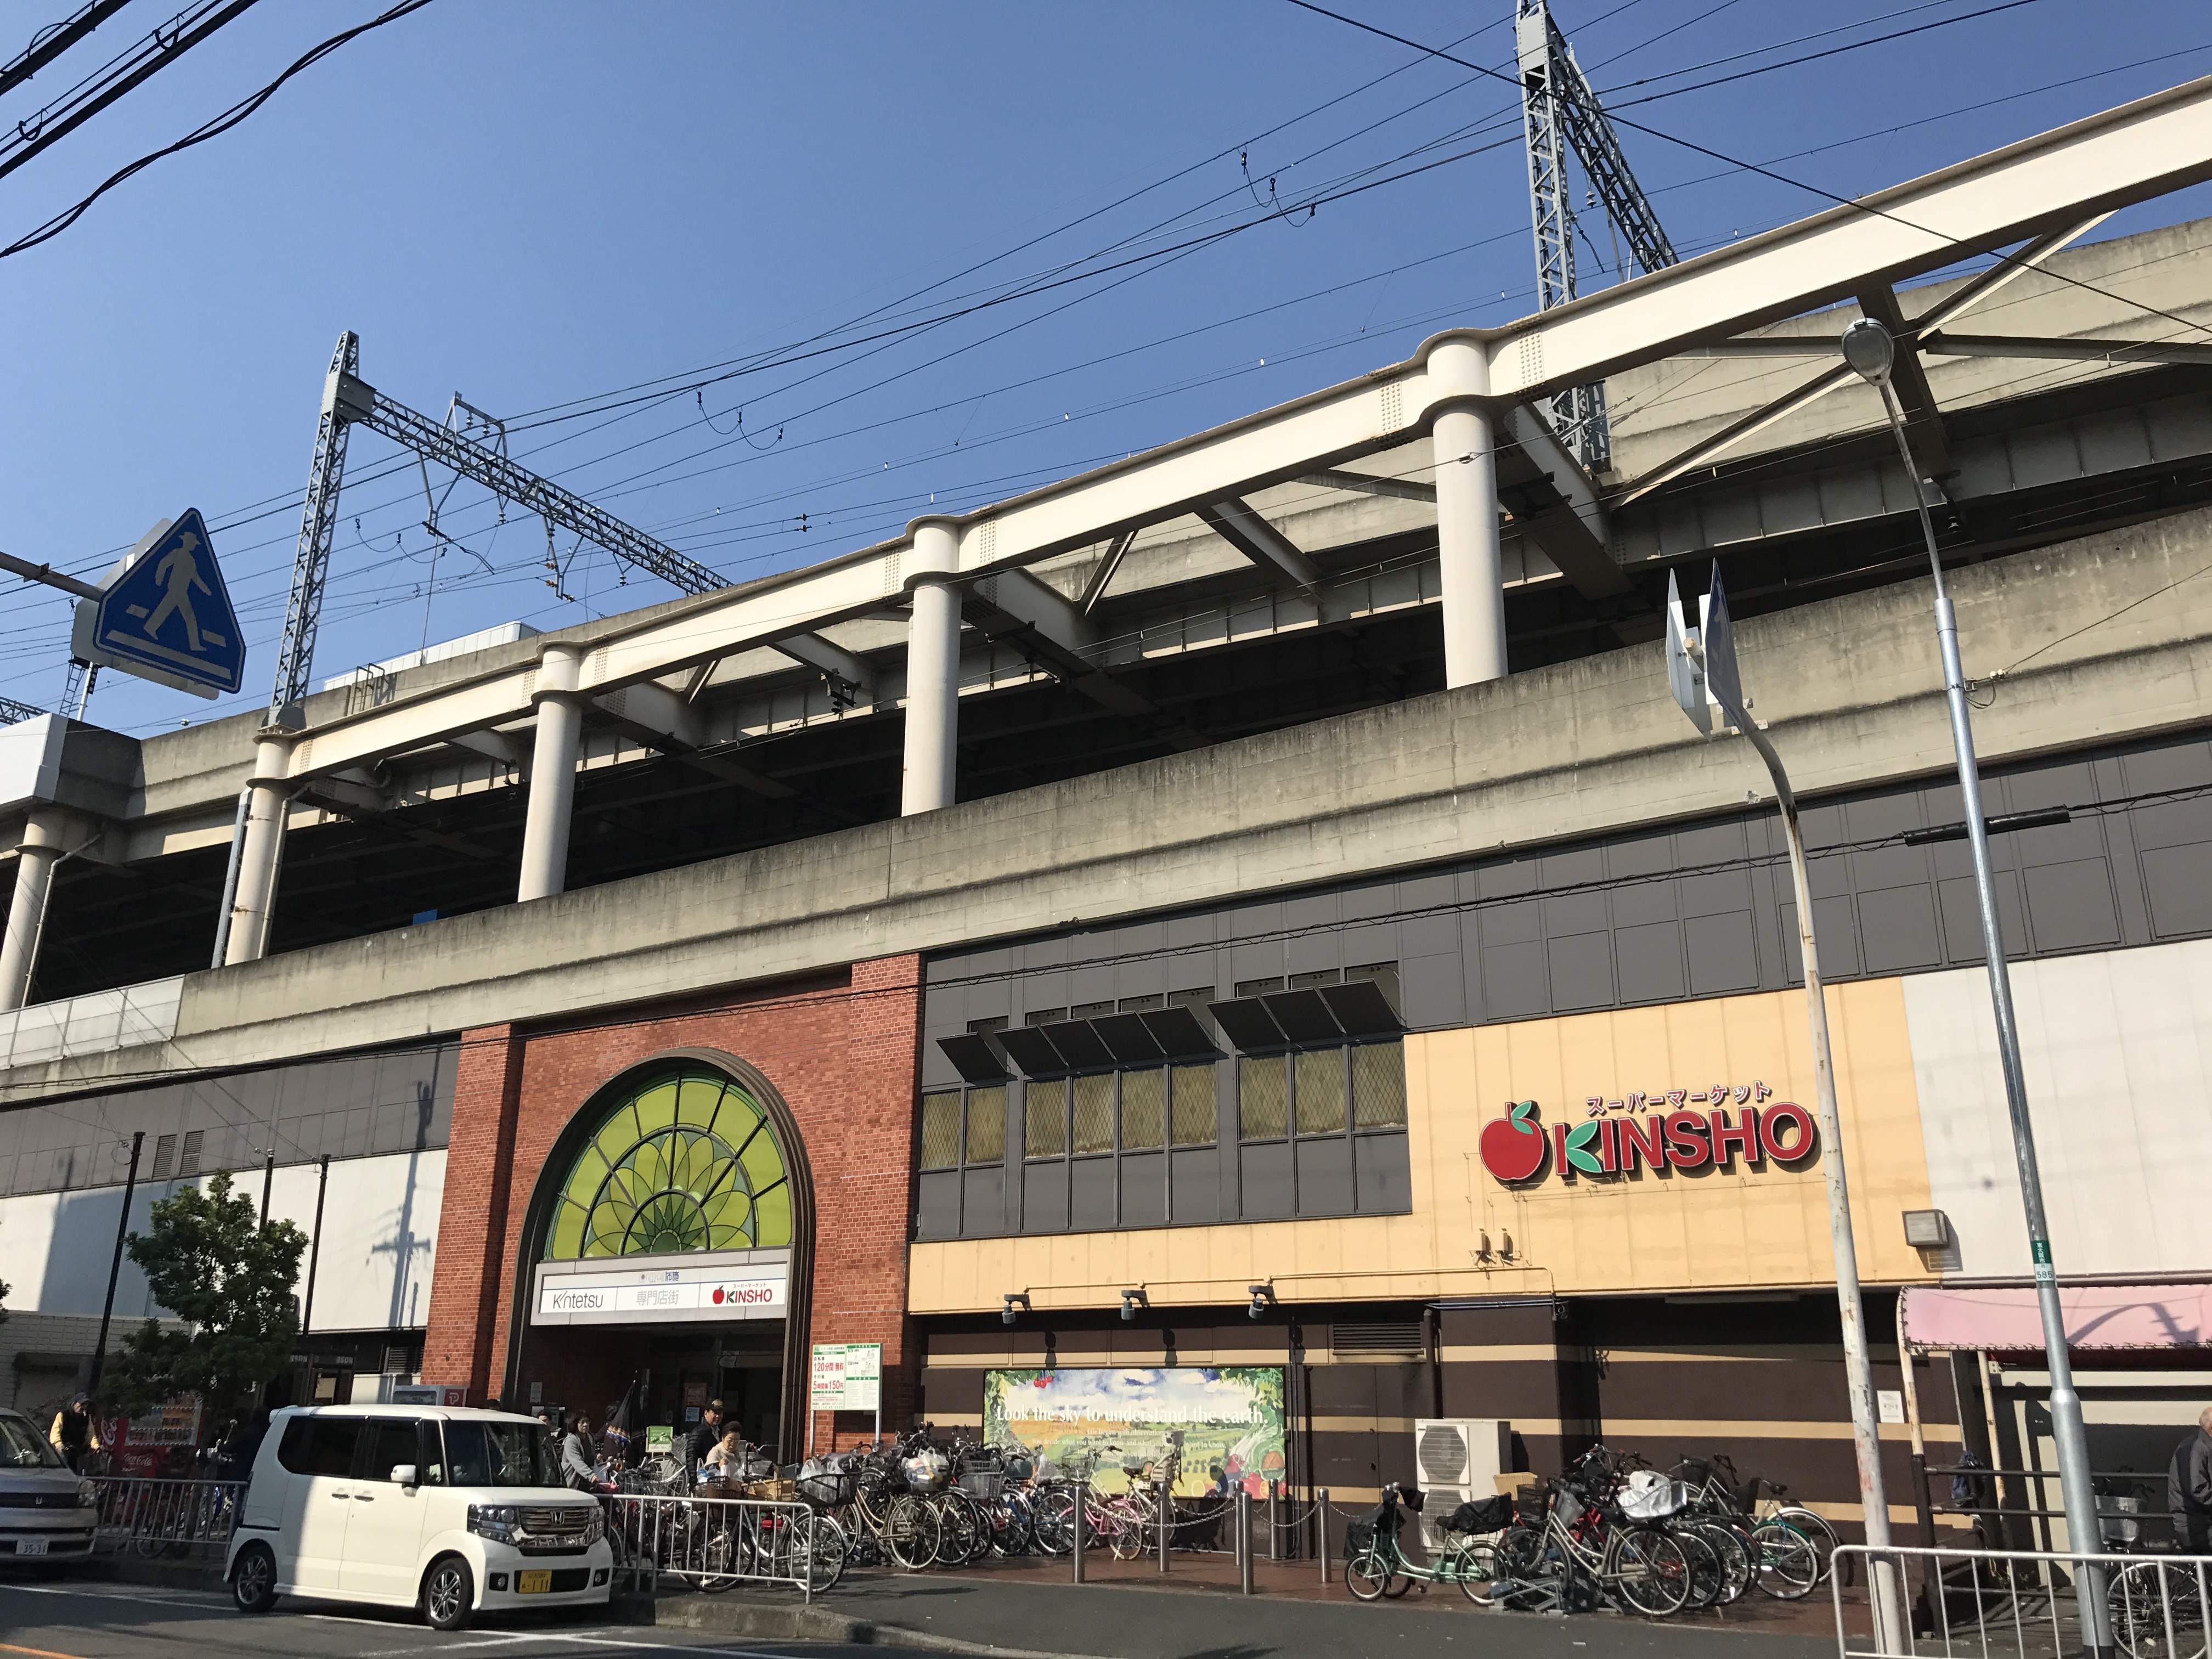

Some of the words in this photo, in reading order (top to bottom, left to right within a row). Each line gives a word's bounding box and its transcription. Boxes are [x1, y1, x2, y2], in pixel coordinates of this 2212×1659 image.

[1586, 1080, 1773, 1117] スーパーマーケット
[1553, 1102, 1813, 1176] KINSHO
[2036, 1242, 2045, 1263] 東大阪市
[636, 1289, 680, 1306] 専門店街
[726, 1289, 772, 1304] KINSHO
[814, 1362, 834, 1372] 120分間
[835, 1362, 844, 1372] 無料
[997, 1405, 1029, 1421] Look
[1034, 1405, 1055, 1421] the
[1059, 1405, 1081, 1426] sky
[1086, 1406, 1101, 1422] to
[1105, 1405, 1187, 1423] understand
[1193, 1406, 1217, 1424] the
[1222, 1406, 1268, 1424] earth.
